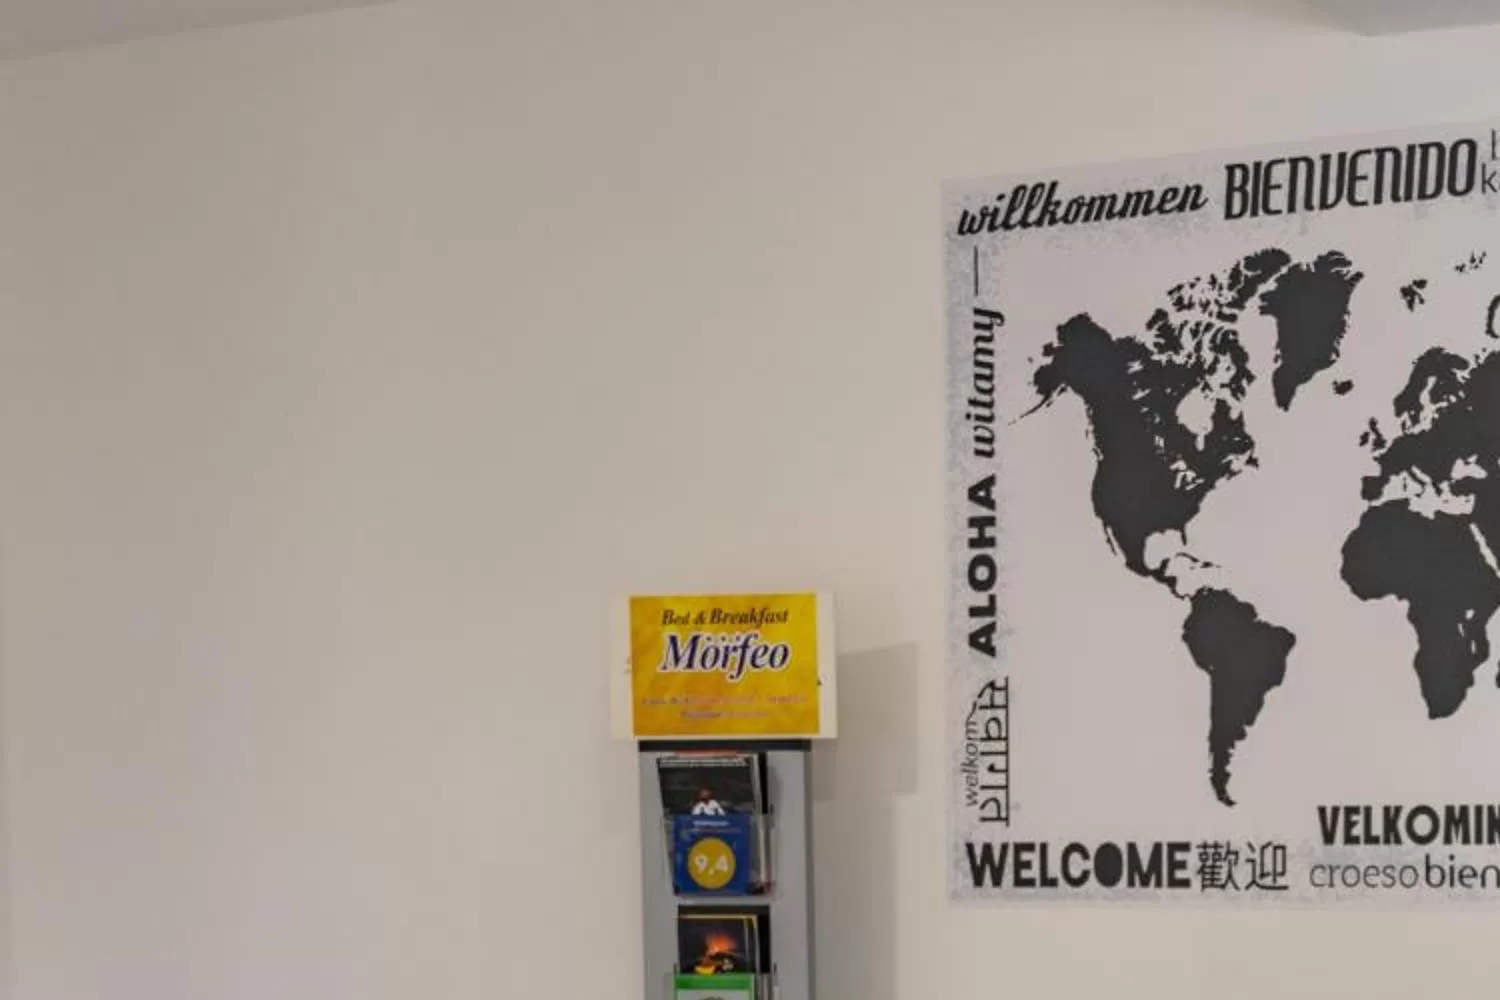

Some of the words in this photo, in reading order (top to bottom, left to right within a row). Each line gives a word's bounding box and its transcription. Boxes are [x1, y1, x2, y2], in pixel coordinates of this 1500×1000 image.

[1223, 139, 1478, 221] BIENVENIDO
[957, 181, 1208, 236] willkommen
[966, 306, 1005, 458] witany
[967, 473, 998, 658] ALOHA
[661, 609, 690, 626] Bed
[709, 607, 789, 628] Breakfast
[961, 719, 979, 807] welkom
[965, 841, 1192, 888] WELCOME
[1195, 840, 1290, 891] 歡迎
[1309, 863, 1419, 889] croeso
